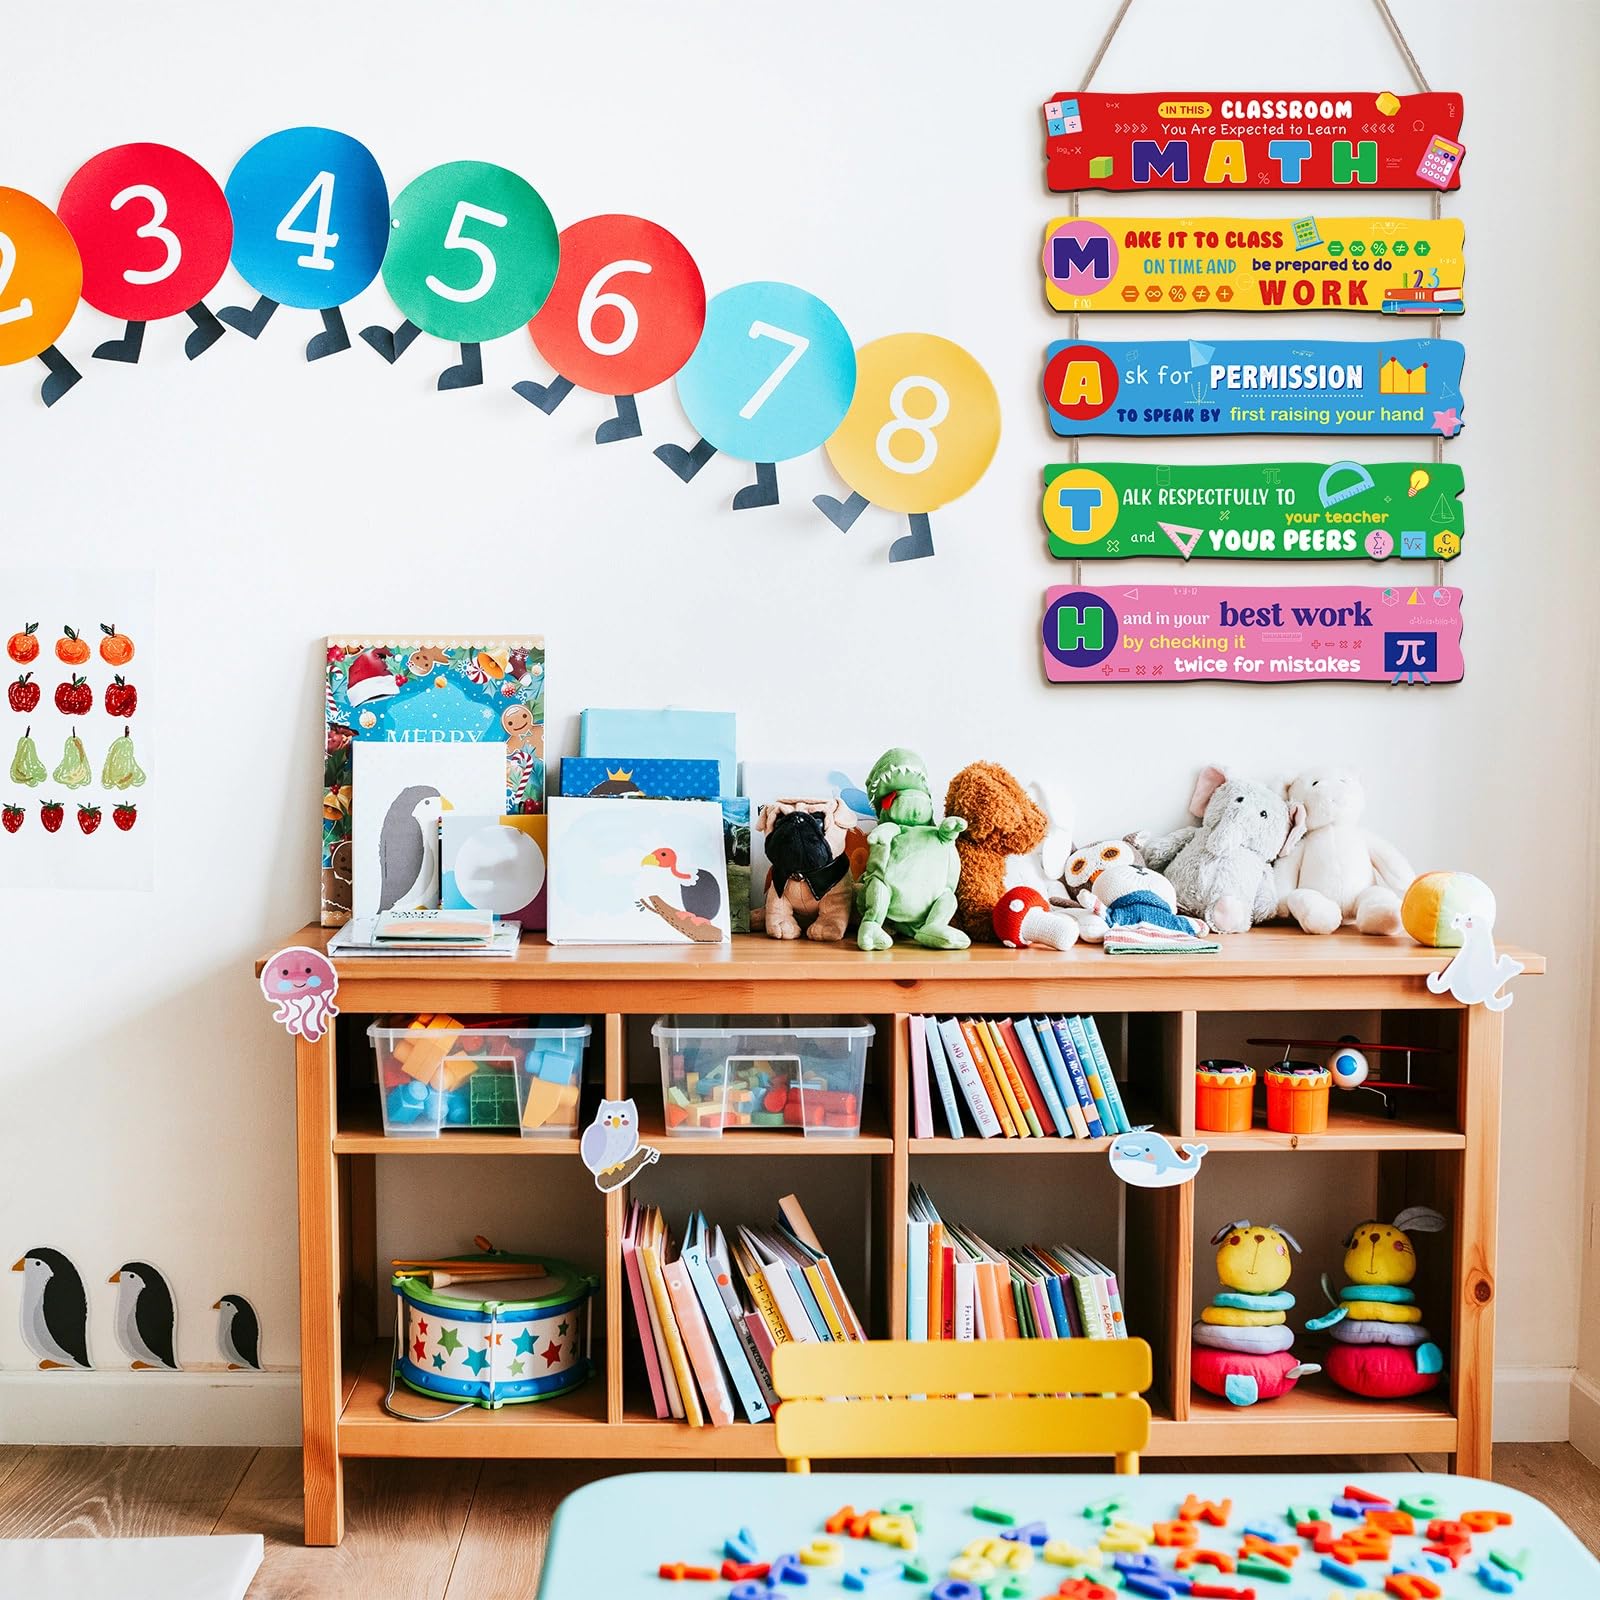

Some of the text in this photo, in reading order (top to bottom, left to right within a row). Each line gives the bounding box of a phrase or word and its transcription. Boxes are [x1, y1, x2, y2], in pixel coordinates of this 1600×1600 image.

[1165, 99, 1353, 119] IN THIS CLASSROOM
[1161, 123, 1347, 138] You Are Expected to Learn
[275, 170, 340, 271] 4
[110, 184, 182, 286] 3
[1168, 231, 1188, 249] IT
[1193, 231, 1219, 249] TO
[1225, 230, 1284, 249] CLASS
[425, 200, 508, 303] 5
[1143, 257, 1393, 275] ON TIME AND be prepared to do
[1258, 279, 1369, 306] WORK
[576, 259, 653, 356] 6
[738, 319, 811, 420] 7
[1157, 364, 1193, 385] for
[1209, 364, 1364, 390] PERMISSION
[875, 375, 951, 475] 8
[1116, 406, 1424, 425] TO SPEAK BY first raising your hand
[1158, 488, 1269, 506] RESPECTFULLY
[1275, 488, 1296, 506] TO
[1284, 510, 1390, 526] your teacher
[1130, 531, 1156, 544] and
[1208, 528, 1276, 552] YOUR
[1283, 528, 1358, 552] PEERS
[1156, 611, 1170, 626] in
[1173, 614, 1210, 629] your
[1219, 600, 1285, 628] best
[1291, 600, 1374, 628] work
[1122, 634, 1247, 653] by checking it
[1173, 655, 1361, 673] twice for mistakes
